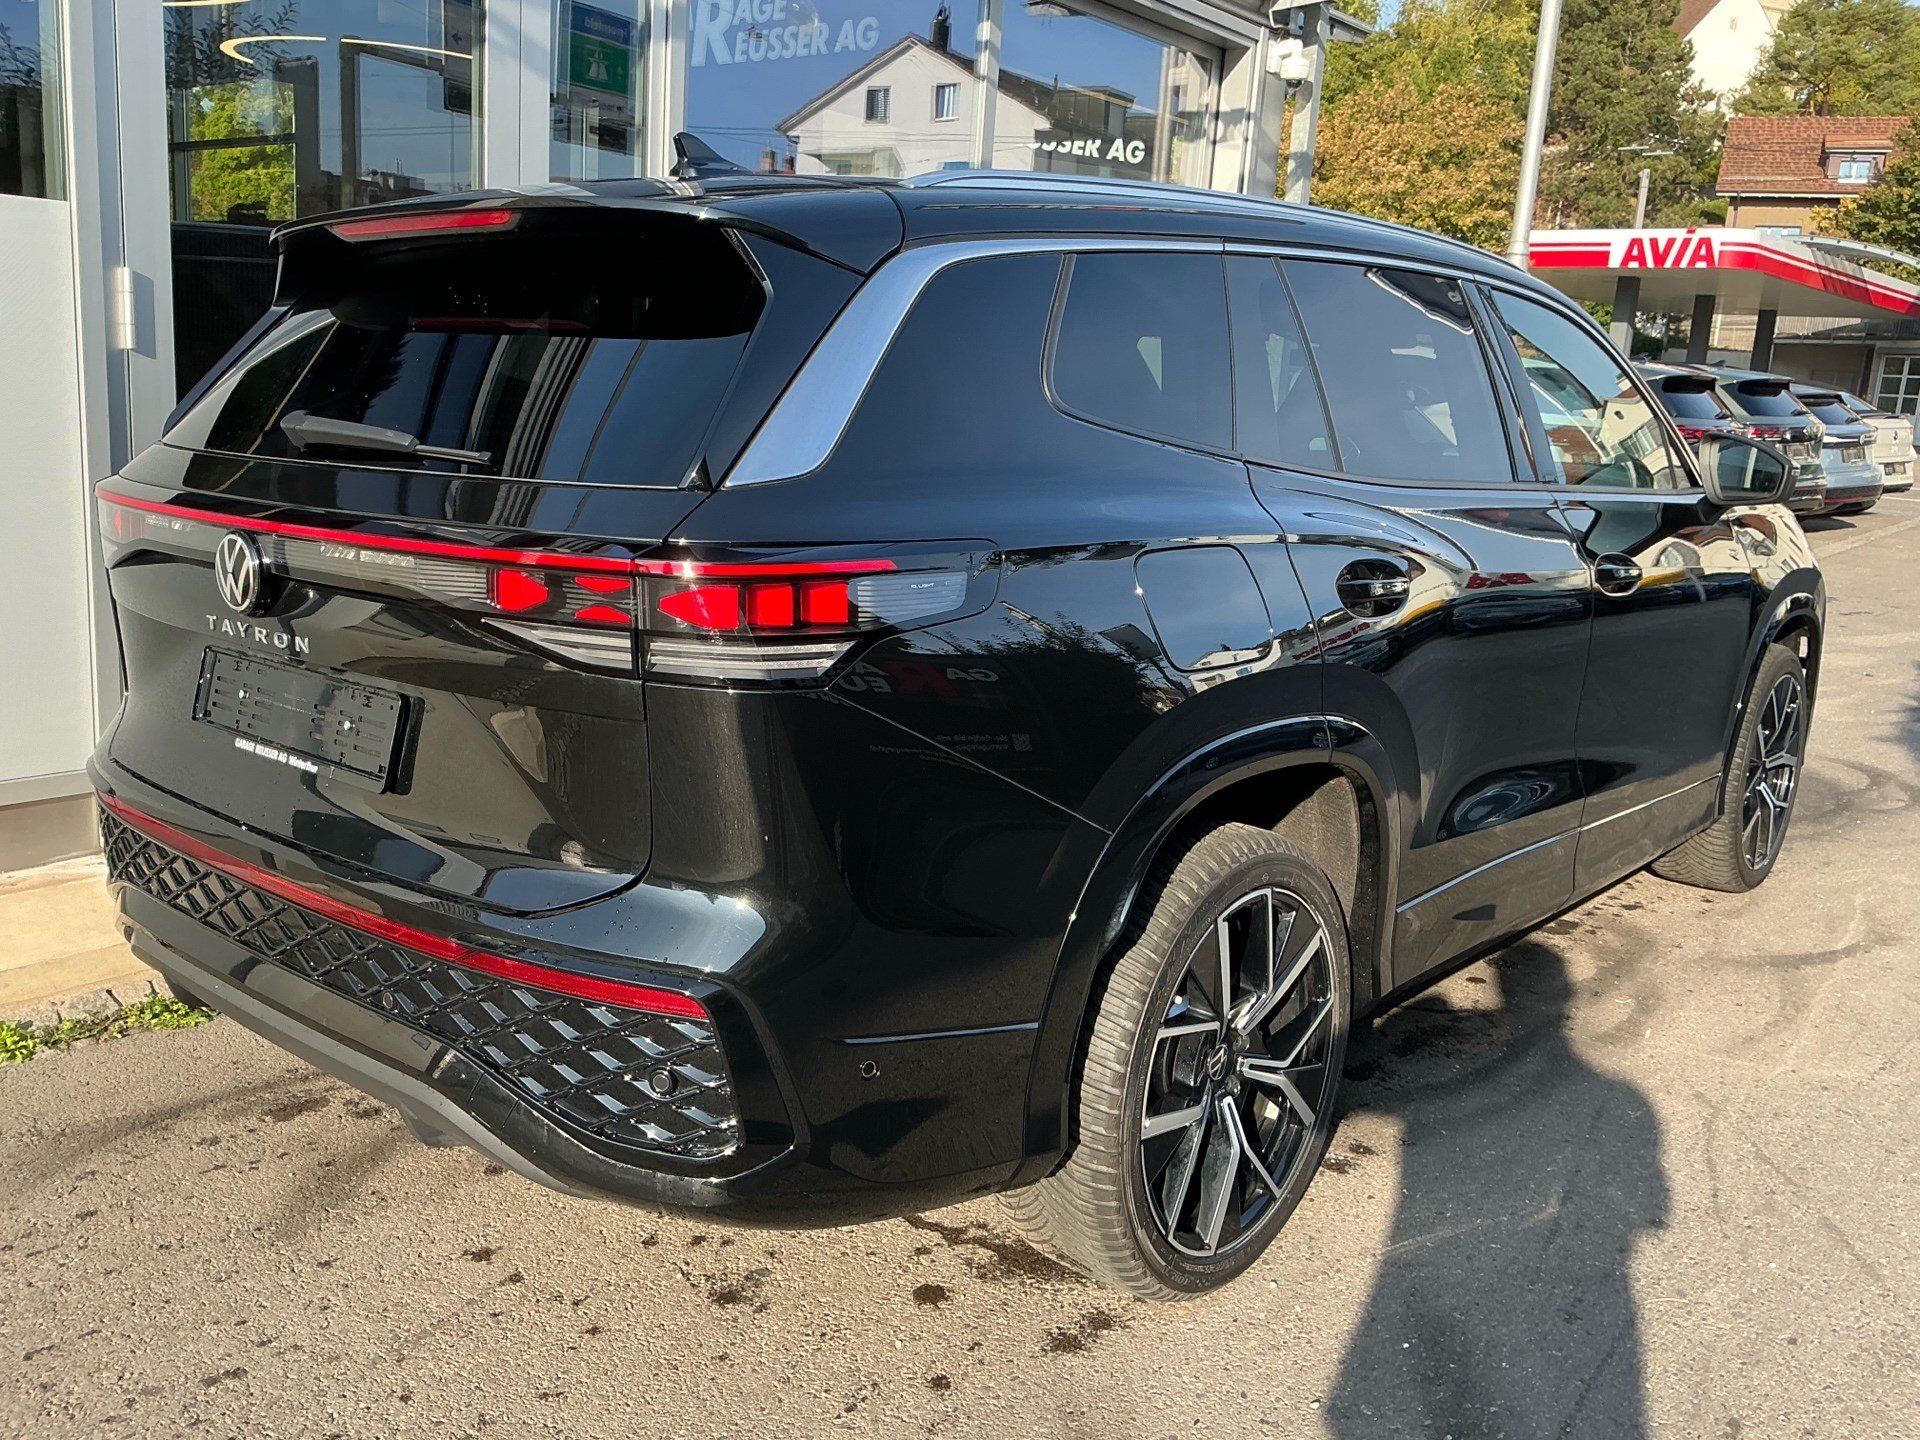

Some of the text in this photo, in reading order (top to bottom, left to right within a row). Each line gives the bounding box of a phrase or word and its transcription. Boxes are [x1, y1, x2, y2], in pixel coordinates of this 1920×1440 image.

[834, 17, 879, 53] AG
[1106, 138, 1146, 164] AG
[1619, 227, 1717, 268] AVIA
[206, 614, 310, 654] TAYRON
[235, 737, 256, 752] GARAGE
[255, 744, 278, 760] REUSSER
[278, 751, 288, 763] AG
